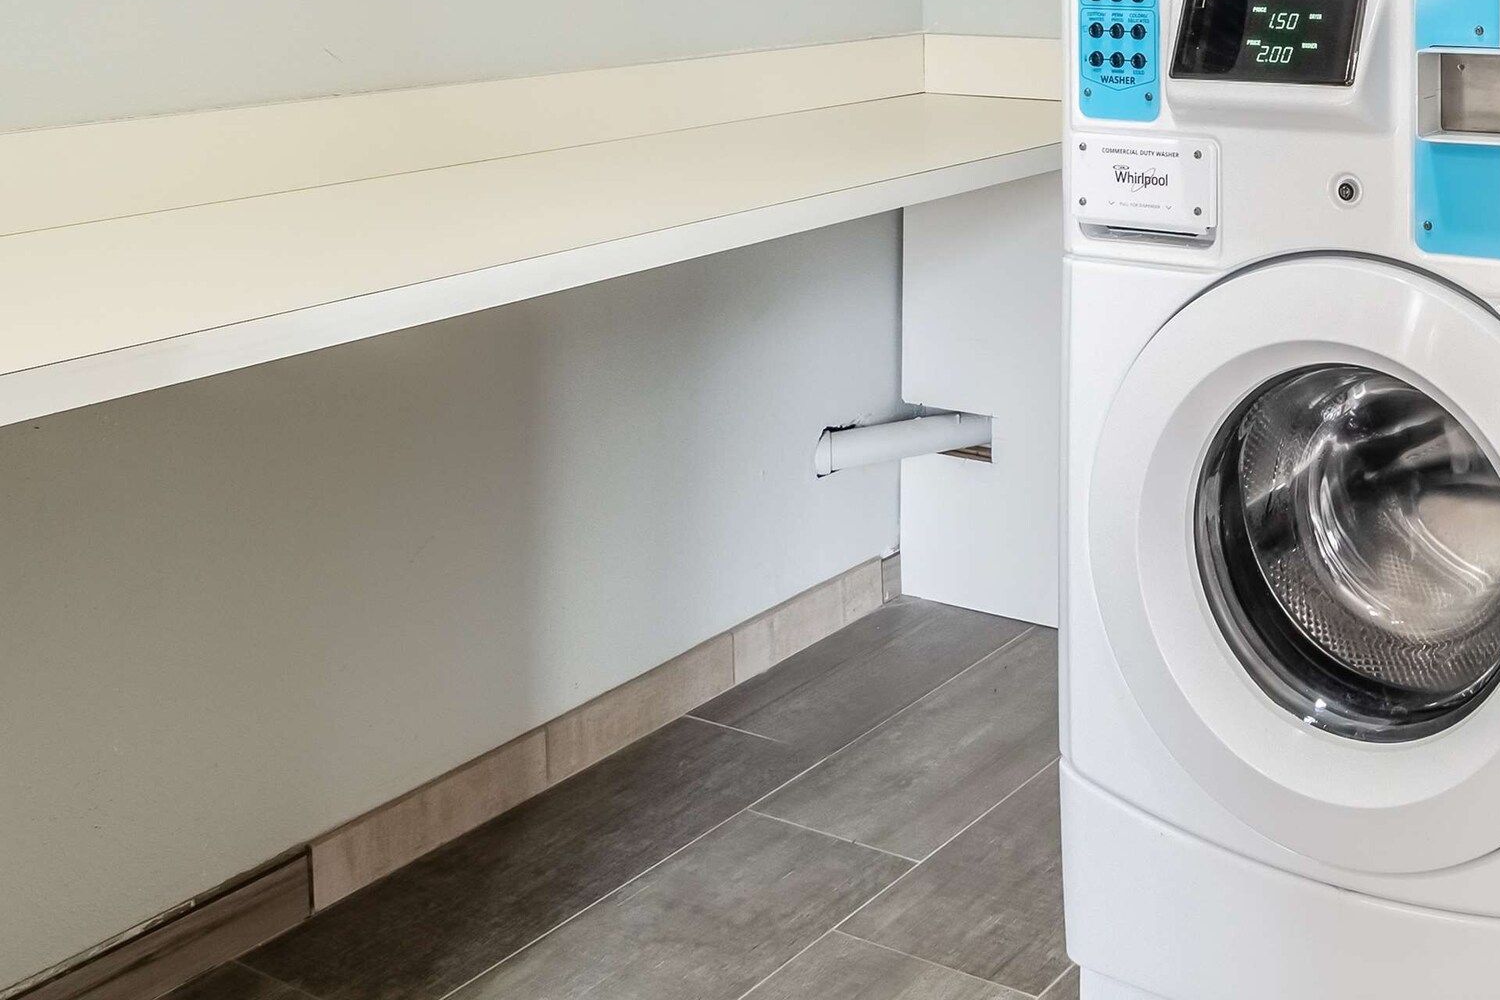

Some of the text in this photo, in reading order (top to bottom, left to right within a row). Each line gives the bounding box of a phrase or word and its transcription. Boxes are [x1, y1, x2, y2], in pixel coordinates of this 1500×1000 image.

[1256, 45, 1294, 63] 2.00
[1101, 75, 1136, 85] WASHER
[1114, 170, 1169, 189] Whirlpool
